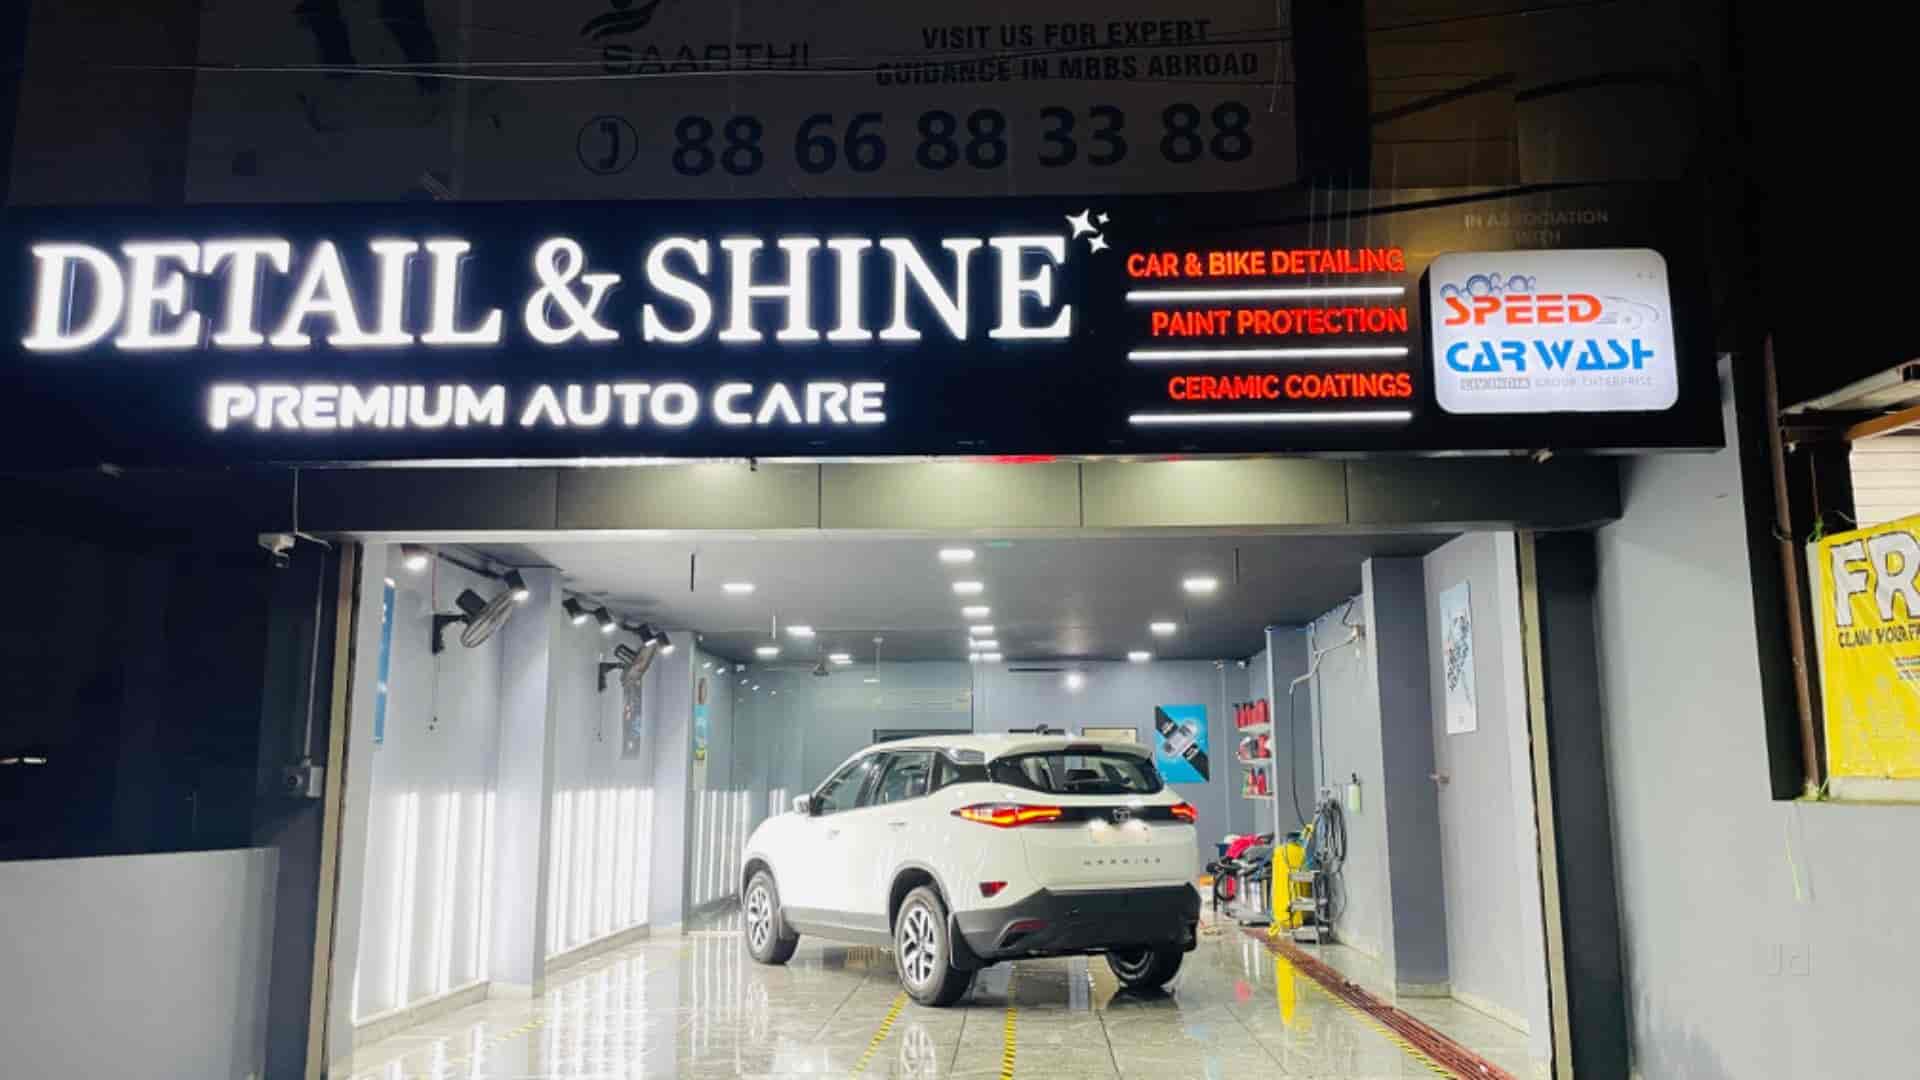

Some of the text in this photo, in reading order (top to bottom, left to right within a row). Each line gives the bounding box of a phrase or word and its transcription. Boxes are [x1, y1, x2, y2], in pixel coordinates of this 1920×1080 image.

[921, 18, 1211, 51] VISIT US FOR EXPERT
[875, 52, 1259, 87] GUIDANCE IN MBBS ABROAD
[672, 101, 1253, 176] 88 66 88 33 88
[1487, 209, 1609, 227] ASOCIATION
[1126, 247, 1406, 278] CAR & BIKE DETAILING
[22, 235, 1072, 351] DETAIL & SHINE
[1444, 293, 1604, 326] SPEED
[1151, 306, 1409, 337] PAINT PROTECTION
[1445, 338, 1655, 372] CAR WASH
[1168, 372, 1413, 400] CERAMIC COATINGS
[208, 381, 886, 430] PREMIUM AUTO CARE
